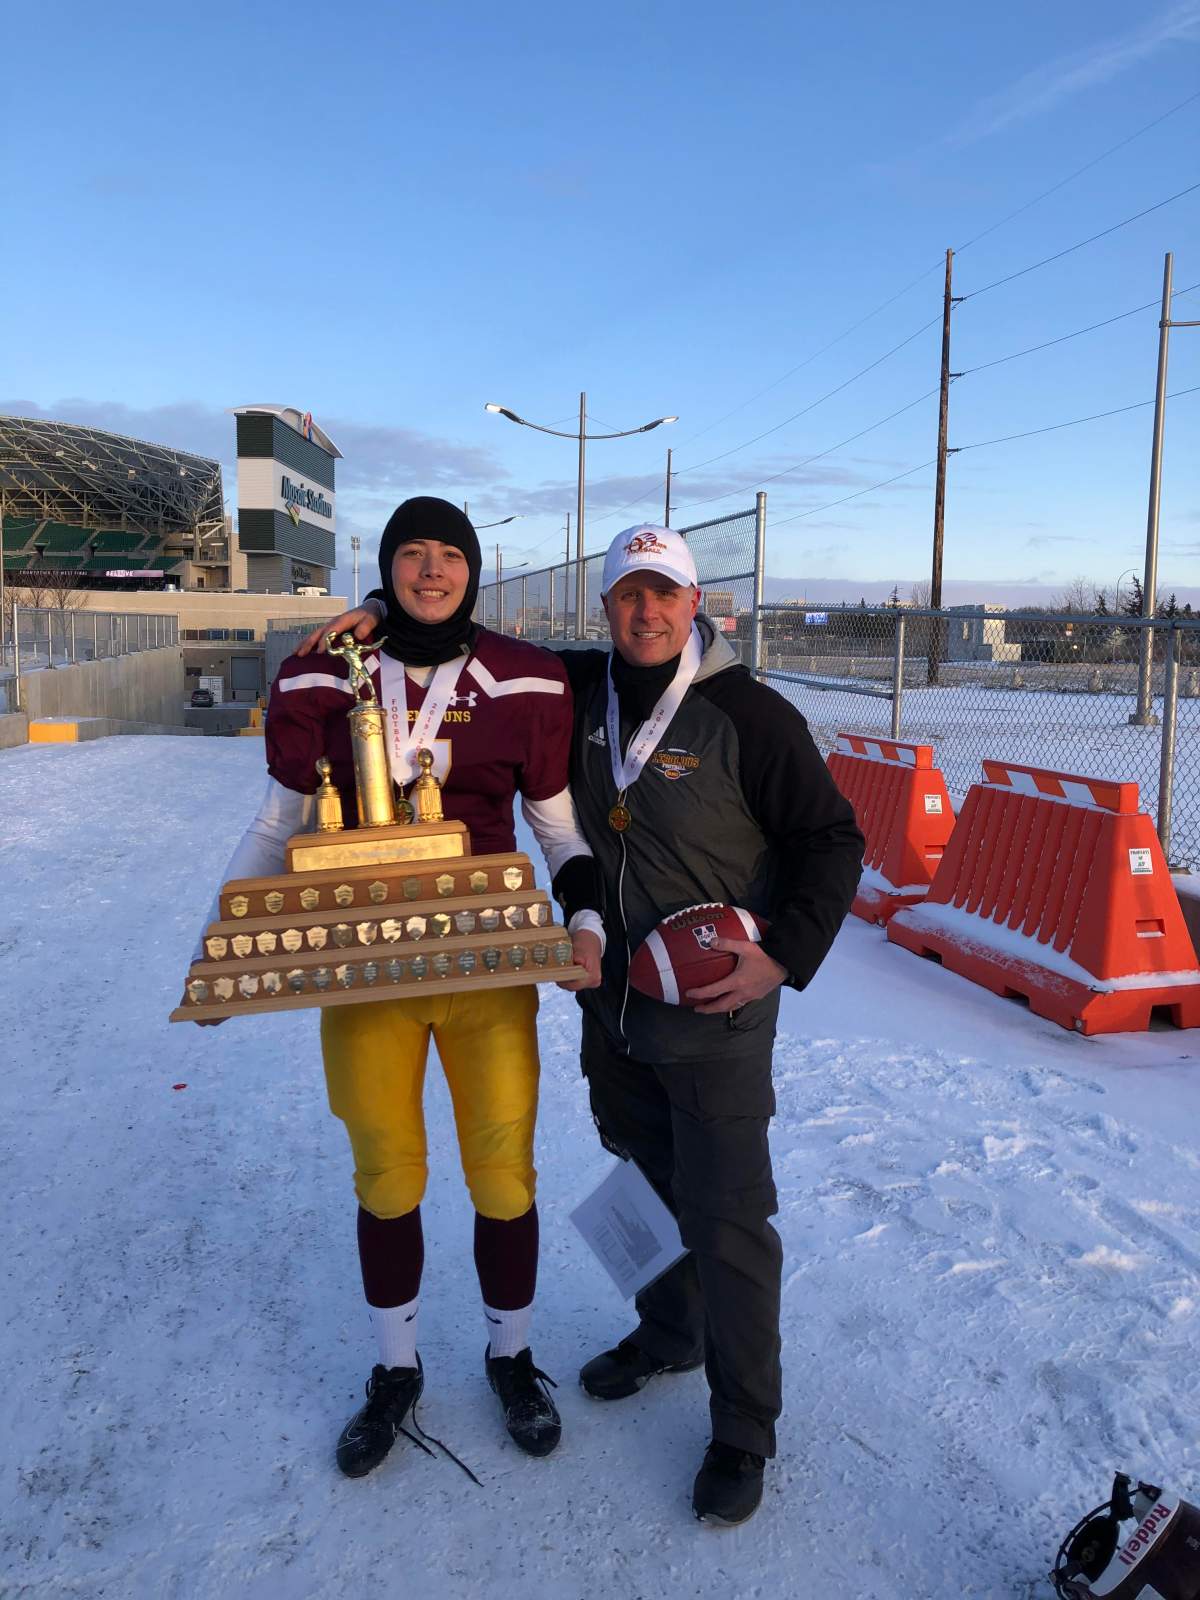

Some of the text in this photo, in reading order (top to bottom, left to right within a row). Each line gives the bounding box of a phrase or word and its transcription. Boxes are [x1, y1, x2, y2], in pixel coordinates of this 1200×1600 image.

[281, 475, 332, 519] Mosaic Stadium
[391, 699, 400, 758] FOOTBALL
[444, 710, 471, 722] UNS
[1118, 1503, 1172, 1566] Riddell
